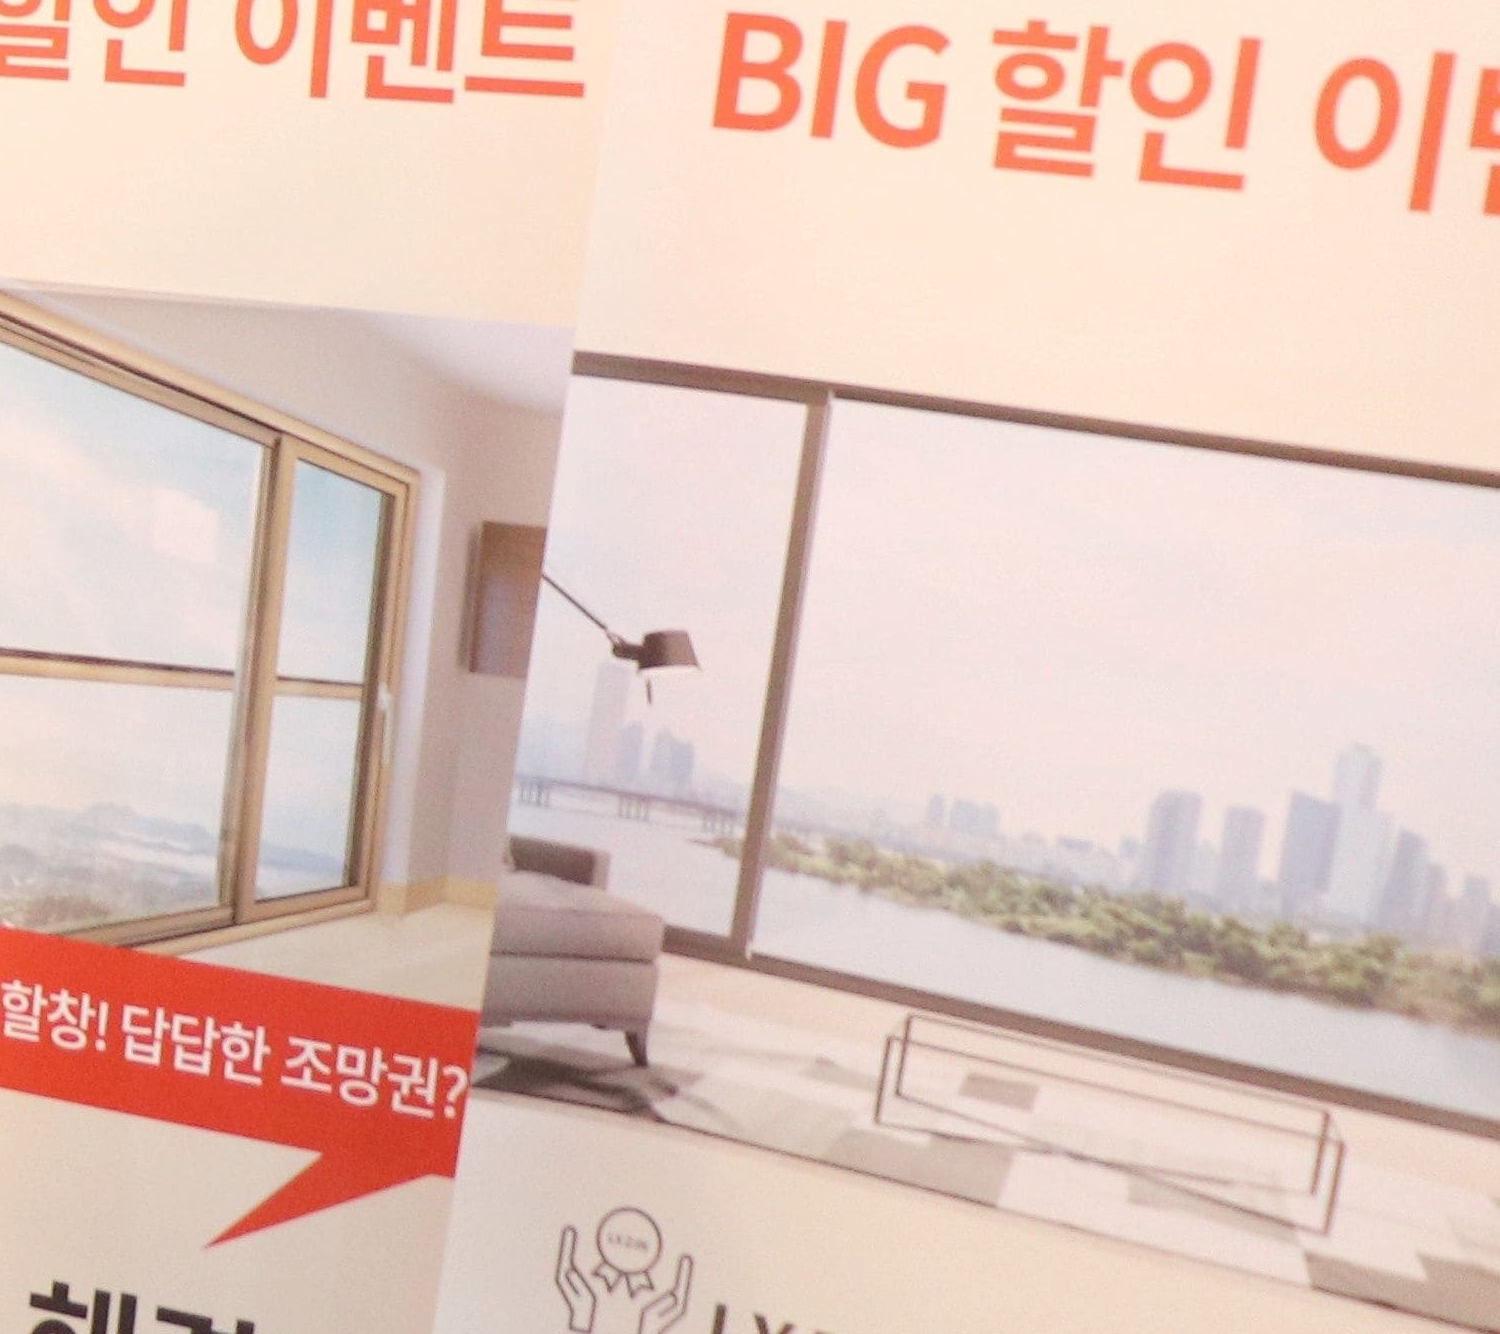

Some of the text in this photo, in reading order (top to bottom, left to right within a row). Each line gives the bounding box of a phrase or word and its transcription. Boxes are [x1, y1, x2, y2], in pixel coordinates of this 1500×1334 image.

[712, 11, 951, 149] BIG
[991, 19, 1264, 192] 할인
[121, 1005, 271, 1084] 답답한
[280, 1039, 468, 1122] 조망권?
